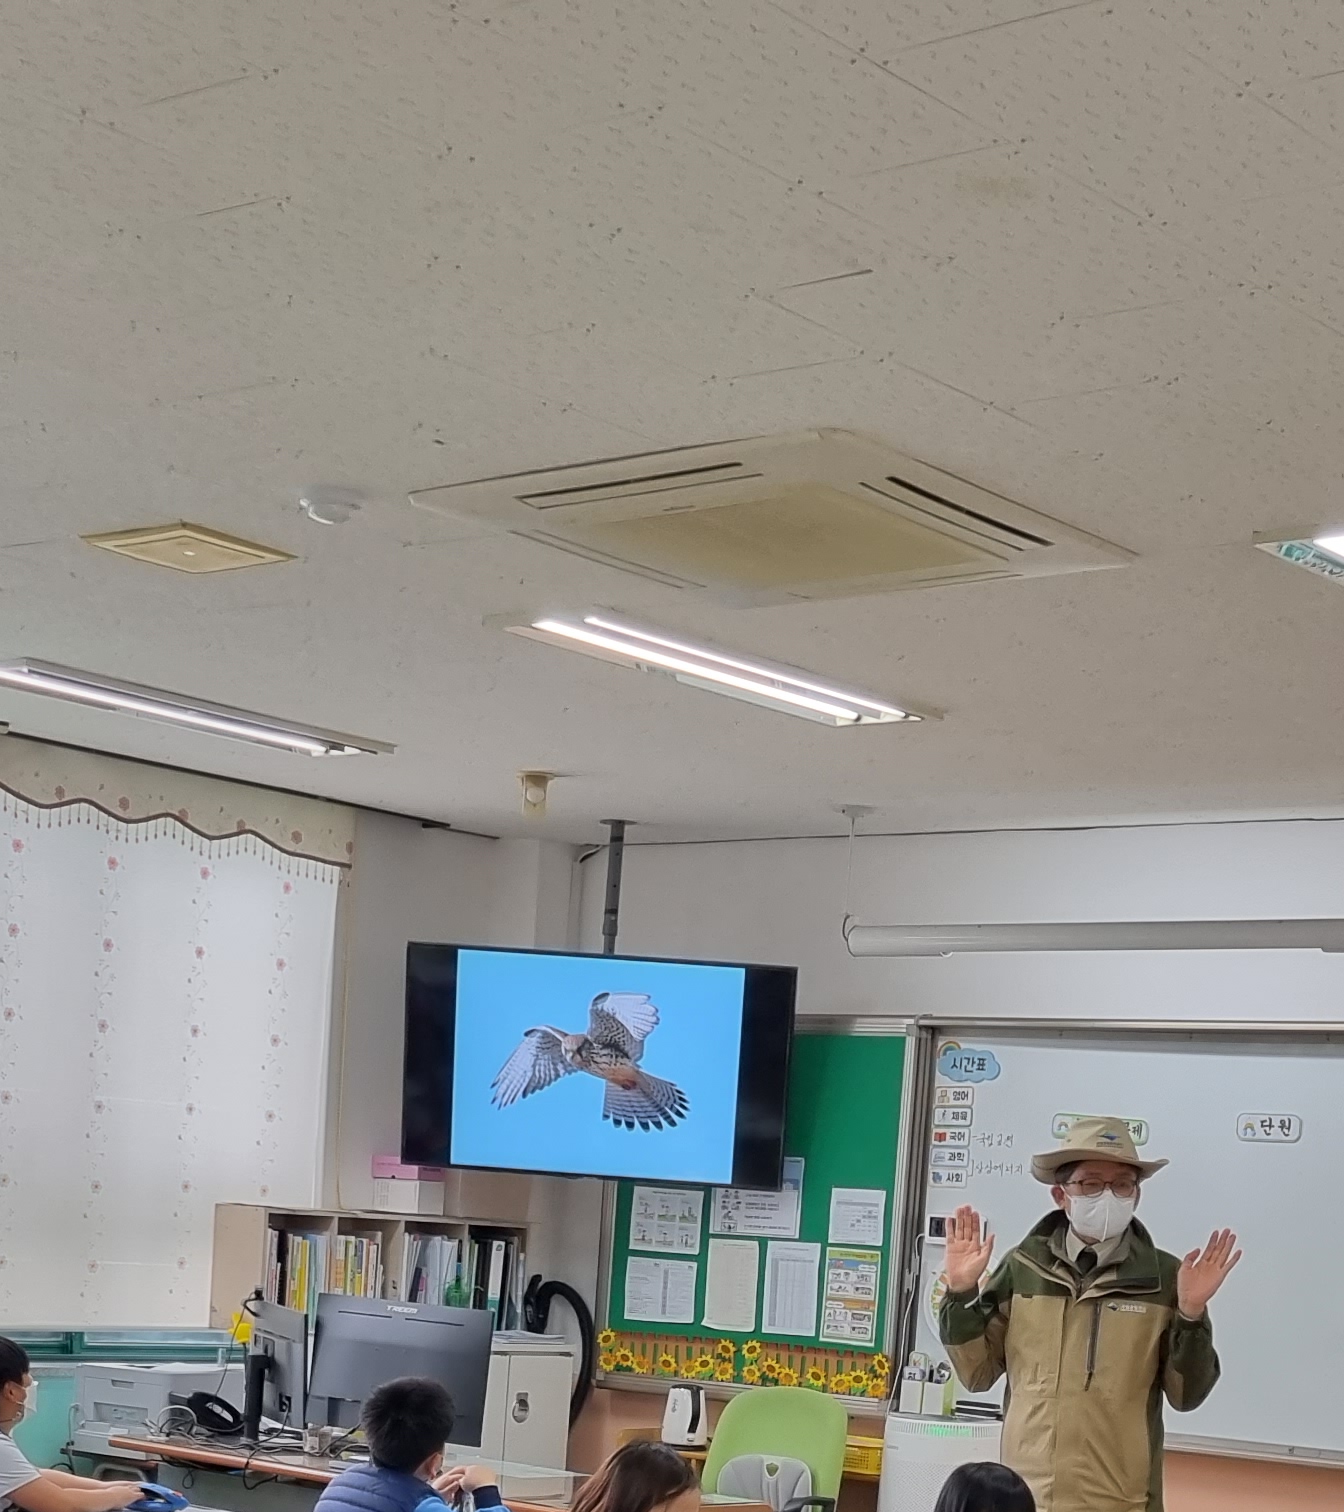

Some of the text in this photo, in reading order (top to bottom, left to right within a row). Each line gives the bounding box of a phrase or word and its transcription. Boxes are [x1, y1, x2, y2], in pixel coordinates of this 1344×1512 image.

[951, 1057, 987, 1073] 시간표
[1259, 1117, 1293, 1137] 단원
[949, 1131, 966, 1141] 국어
[947, 1152, 965, 1162] 과학
[946, 1173, 963, 1183] 사회
